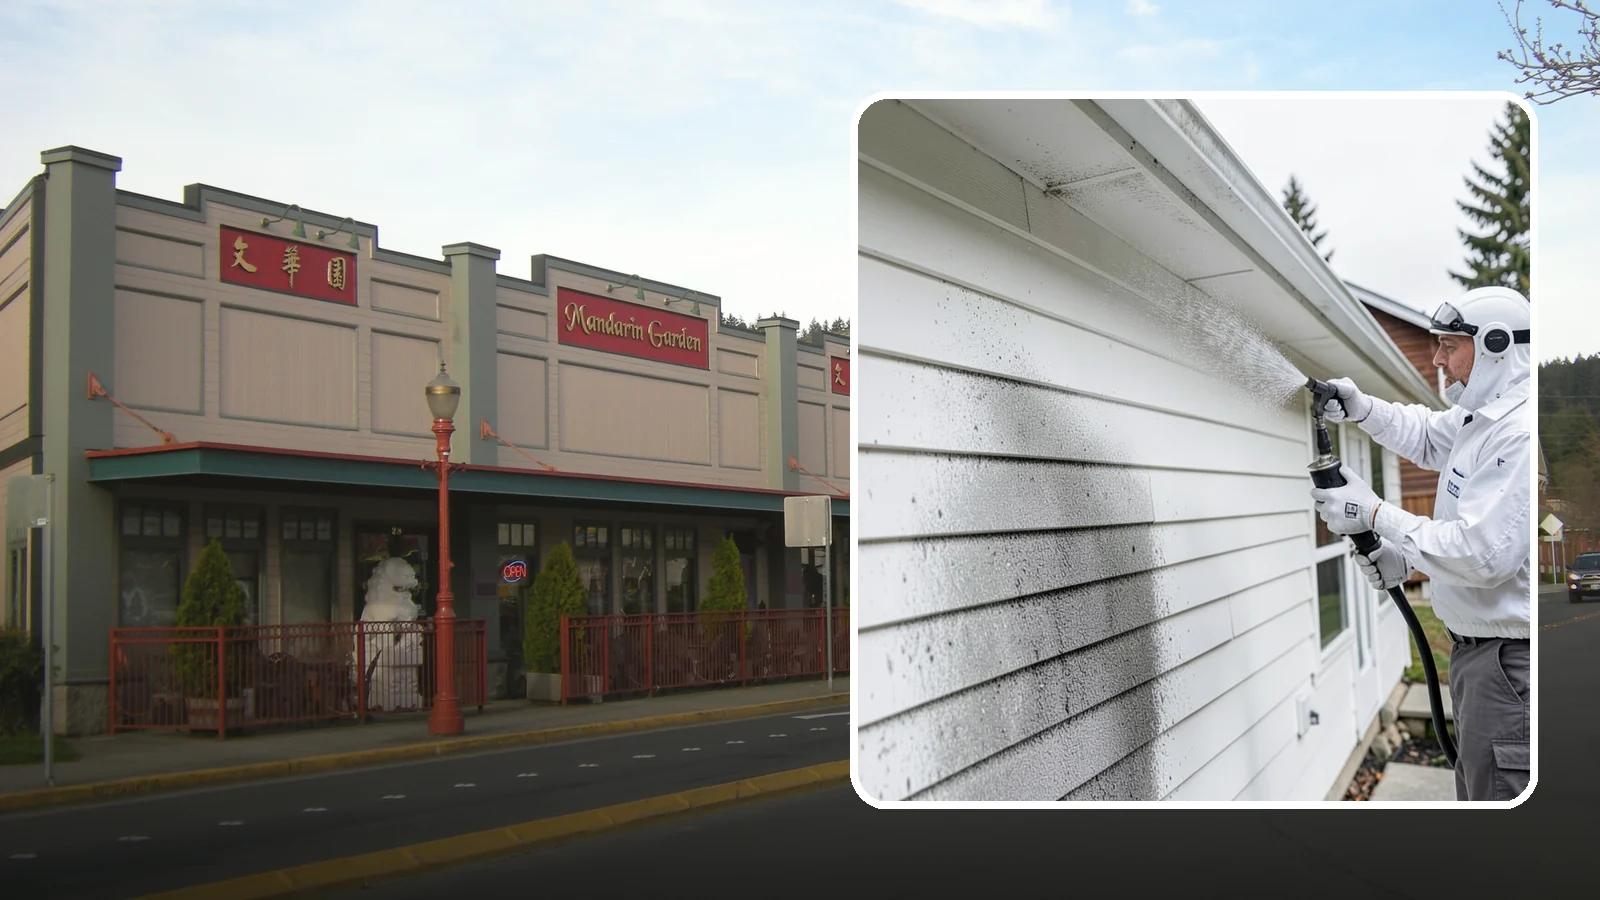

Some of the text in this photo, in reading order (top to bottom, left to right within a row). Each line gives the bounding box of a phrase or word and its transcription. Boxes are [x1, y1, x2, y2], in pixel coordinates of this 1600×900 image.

[231, 235, 346, 291] 文華園
[564, 302, 702, 352] Mandarin Garden
[835, 363, 847, 386] 文
[503, 565, 527, 578] OPEN
